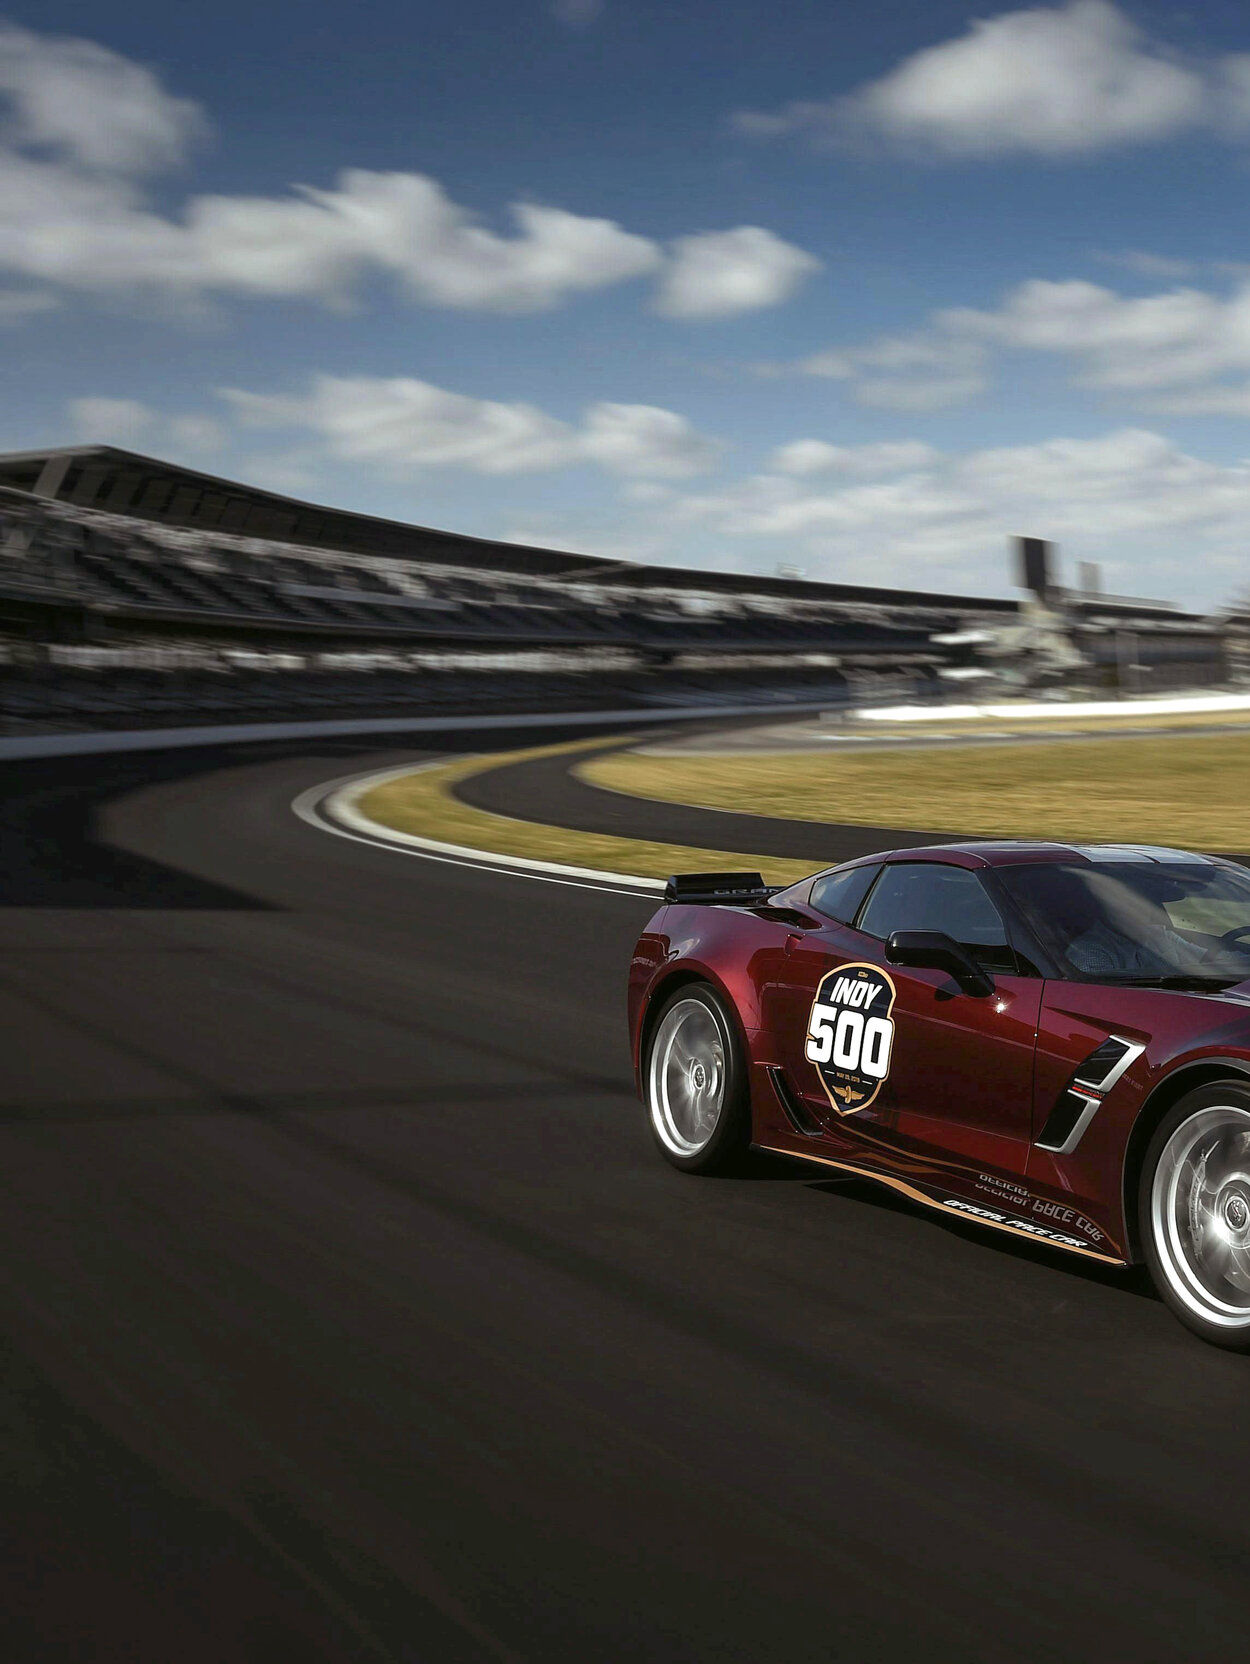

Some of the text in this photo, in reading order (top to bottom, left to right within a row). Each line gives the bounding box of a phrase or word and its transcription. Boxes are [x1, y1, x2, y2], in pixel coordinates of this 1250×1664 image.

[830, 976, 884, 1010] INDY
[806, 1002, 893, 1079] 500
[943, 1199, 1089, 1247] OFFICIAL PACE CAR
